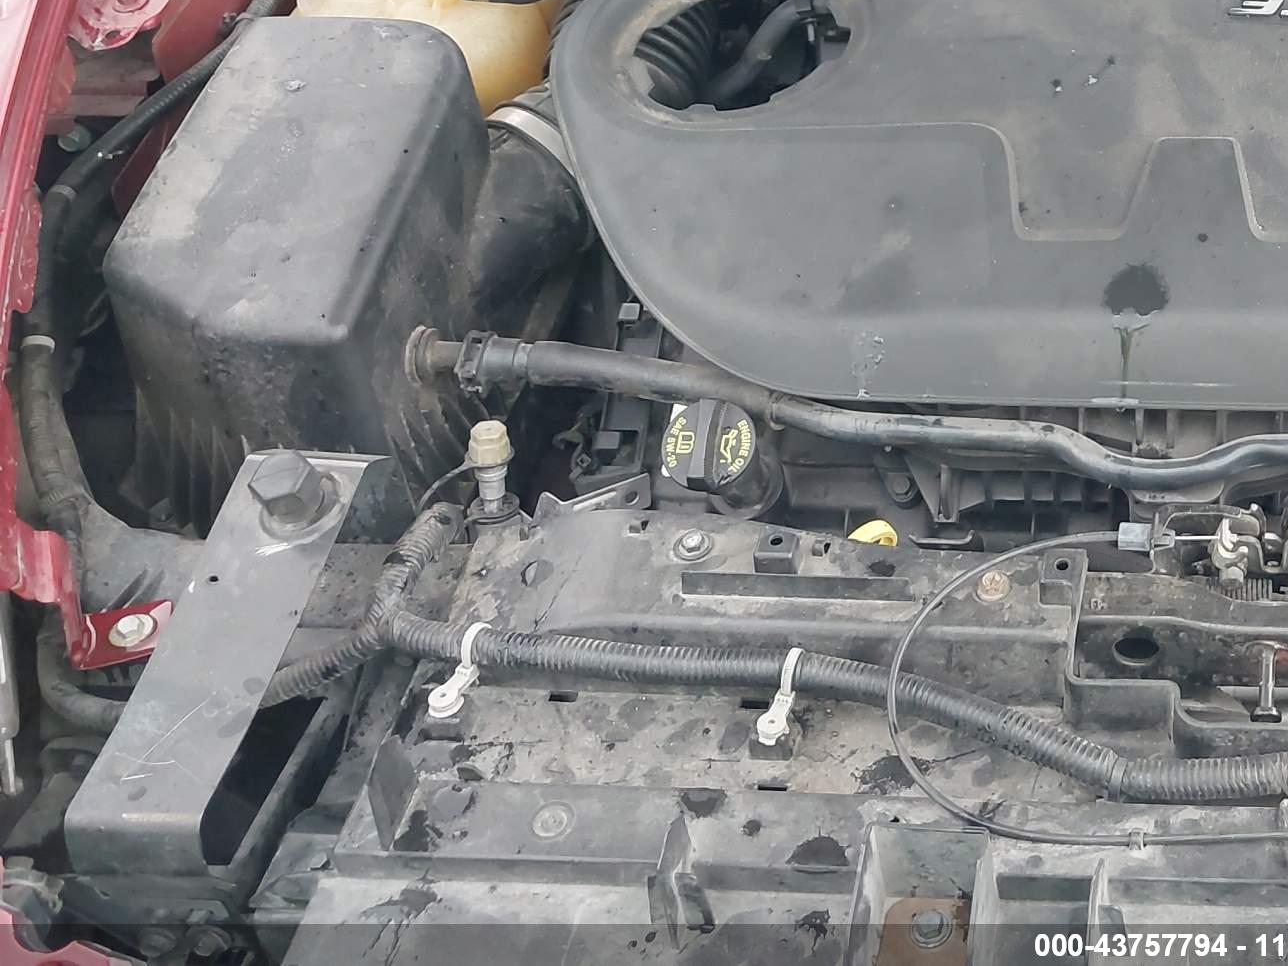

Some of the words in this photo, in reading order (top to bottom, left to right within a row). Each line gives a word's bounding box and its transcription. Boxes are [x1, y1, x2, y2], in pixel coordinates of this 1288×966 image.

[670, 416, 687, 436] SAE
[737, 419, 752, 457] ENGINE
[666, 436, 678, 468] 5W-20
[727, 457, 745, 473] OIL
